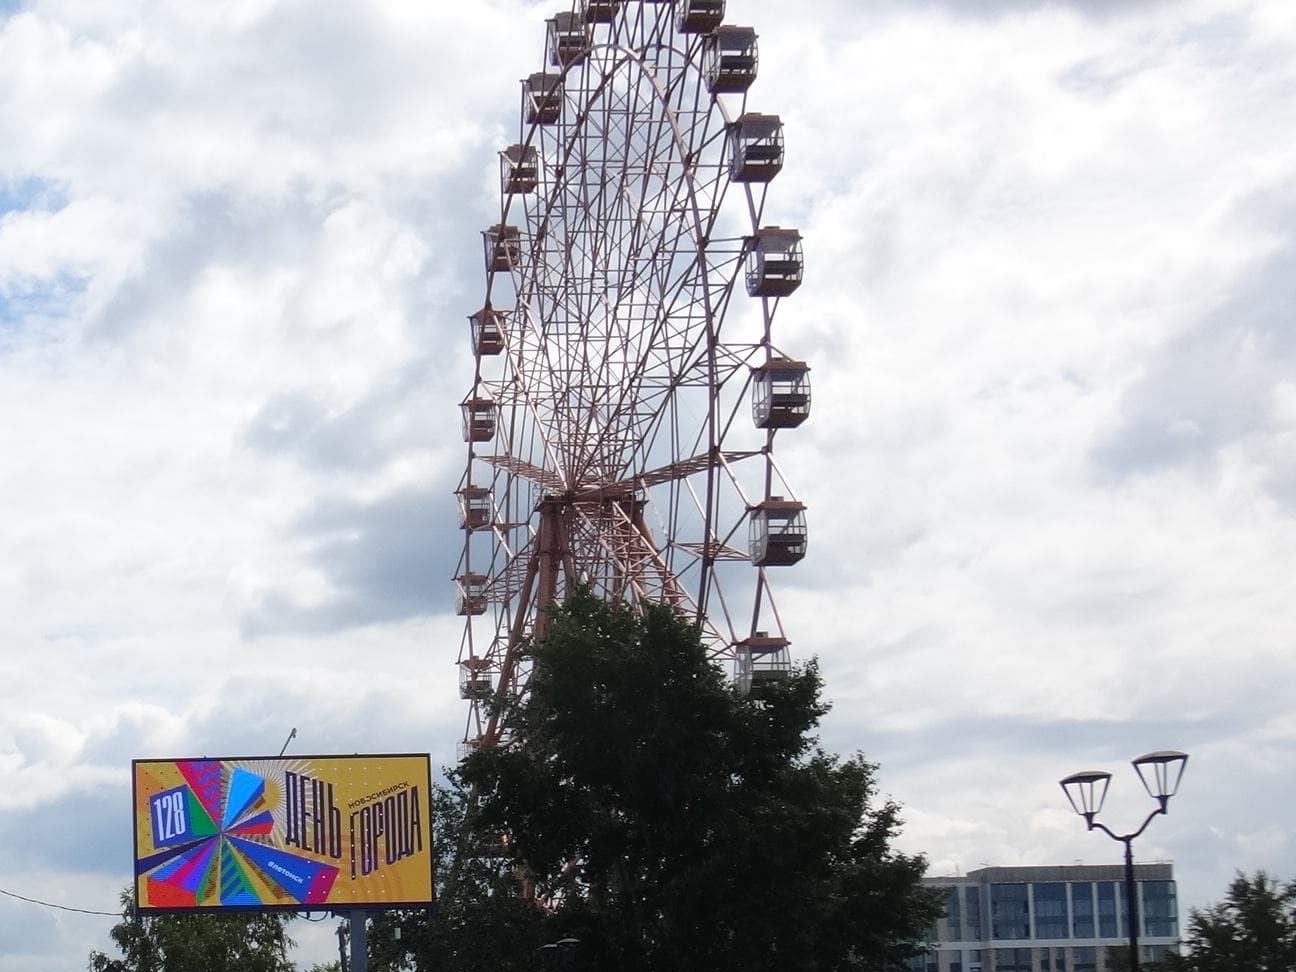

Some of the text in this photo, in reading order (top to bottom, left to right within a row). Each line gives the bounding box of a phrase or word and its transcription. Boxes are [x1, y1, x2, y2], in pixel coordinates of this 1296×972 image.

[154, 791, 188, 842] 128
[285, 770, 342, 859] ДЕНЬ
[347, 780, 410, 808] НОВОСИБИРСК
[349, 785, 423, 880] ГОРОДА
